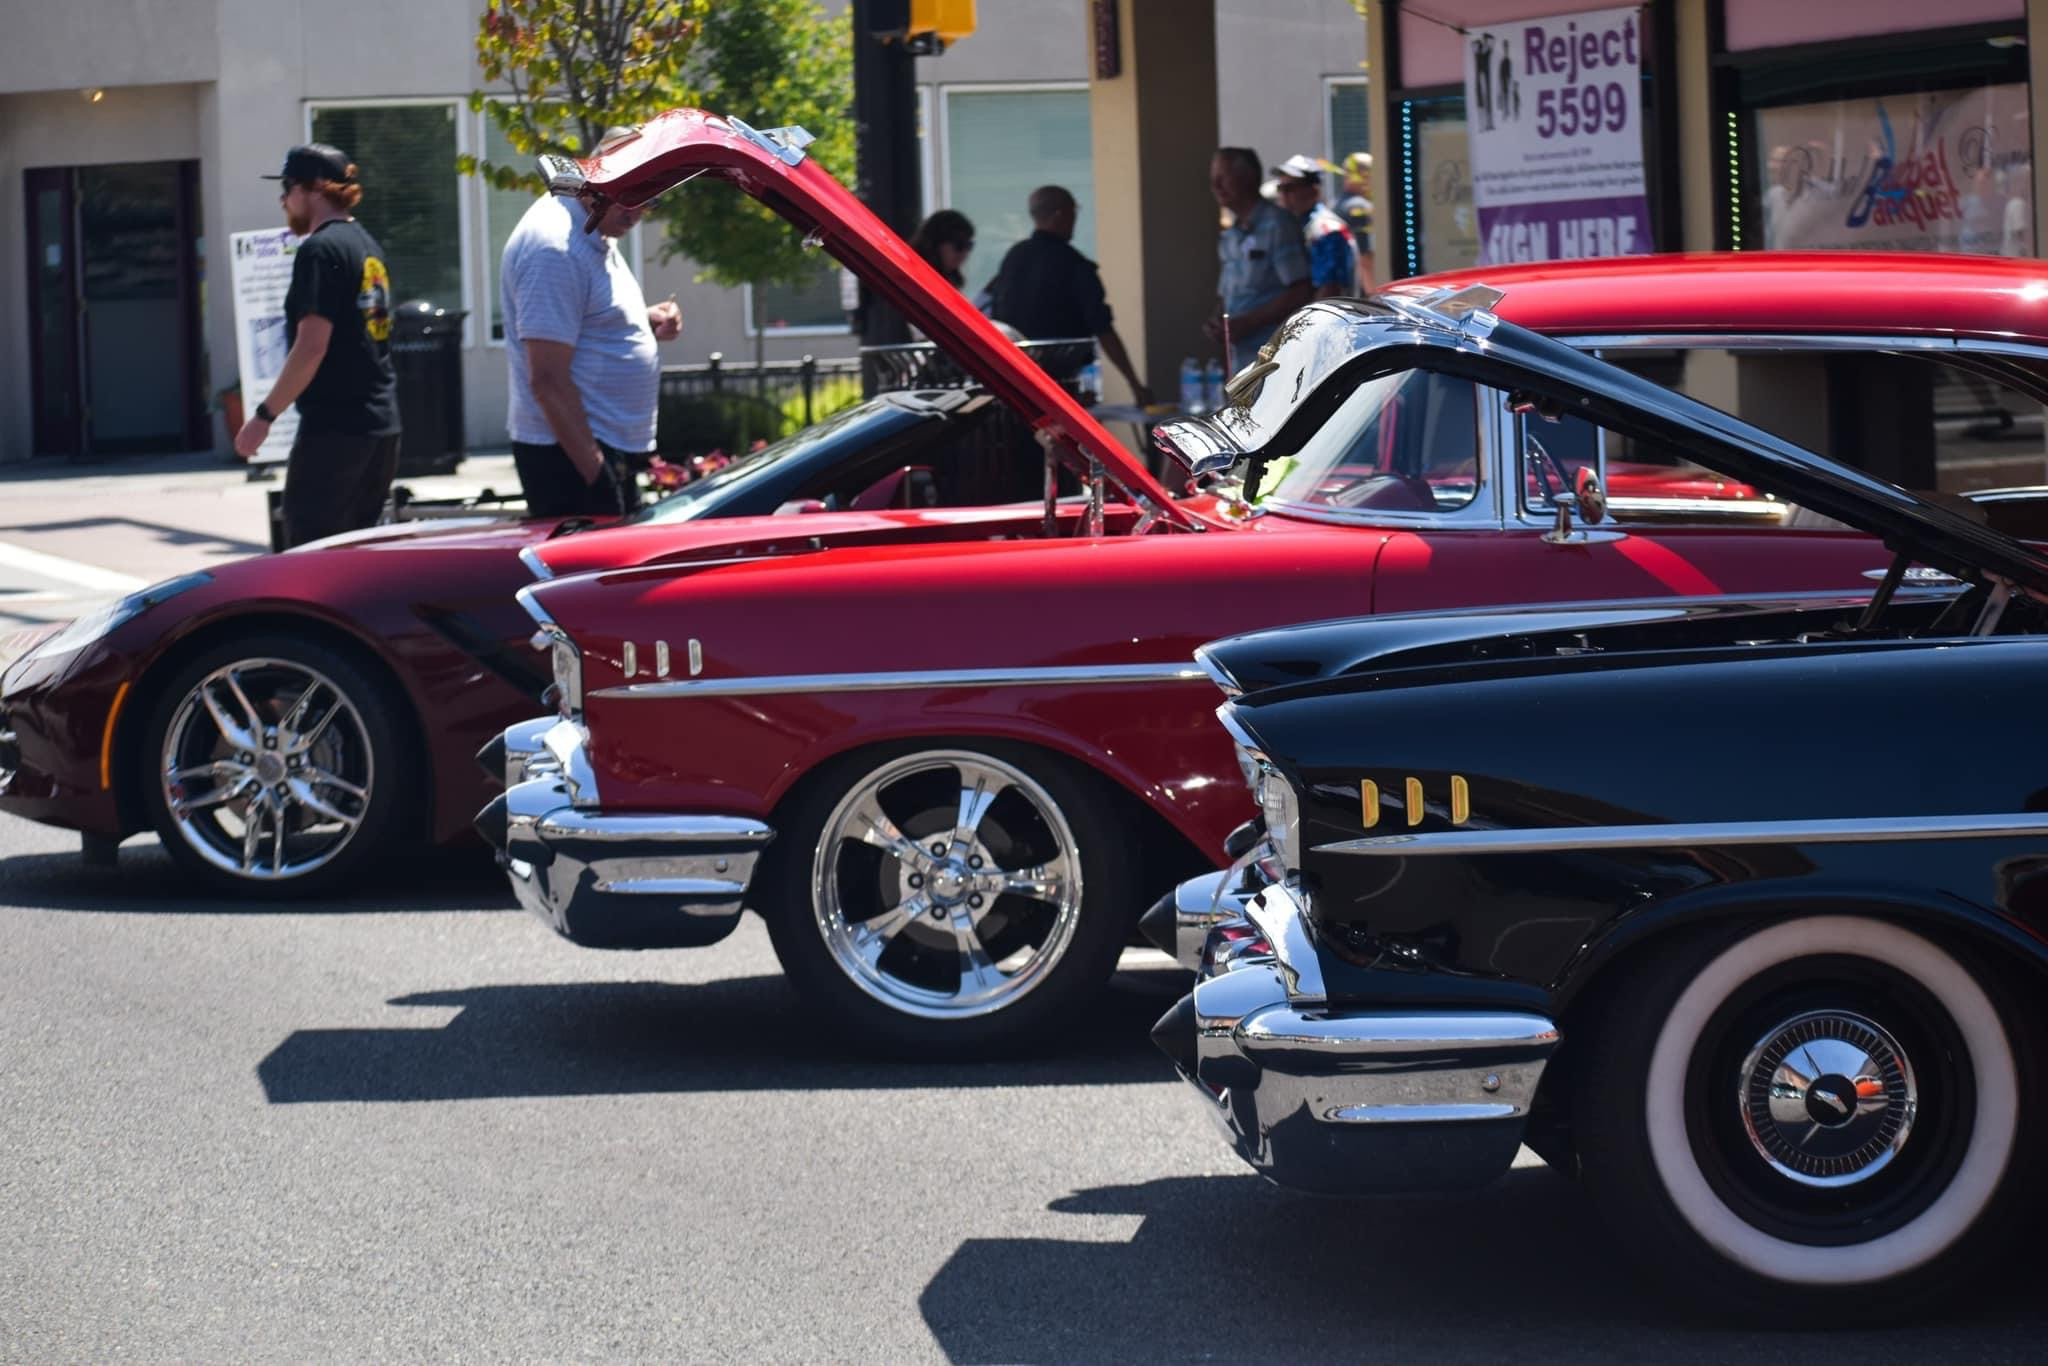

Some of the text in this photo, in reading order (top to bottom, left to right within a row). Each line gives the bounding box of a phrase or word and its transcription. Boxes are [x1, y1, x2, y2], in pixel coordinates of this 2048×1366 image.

[1524, 17, 1638, 84] Reject
[1536, 82, 1627, 139] 5599
[1488, 216, 1637, 265] SIGN HERE
